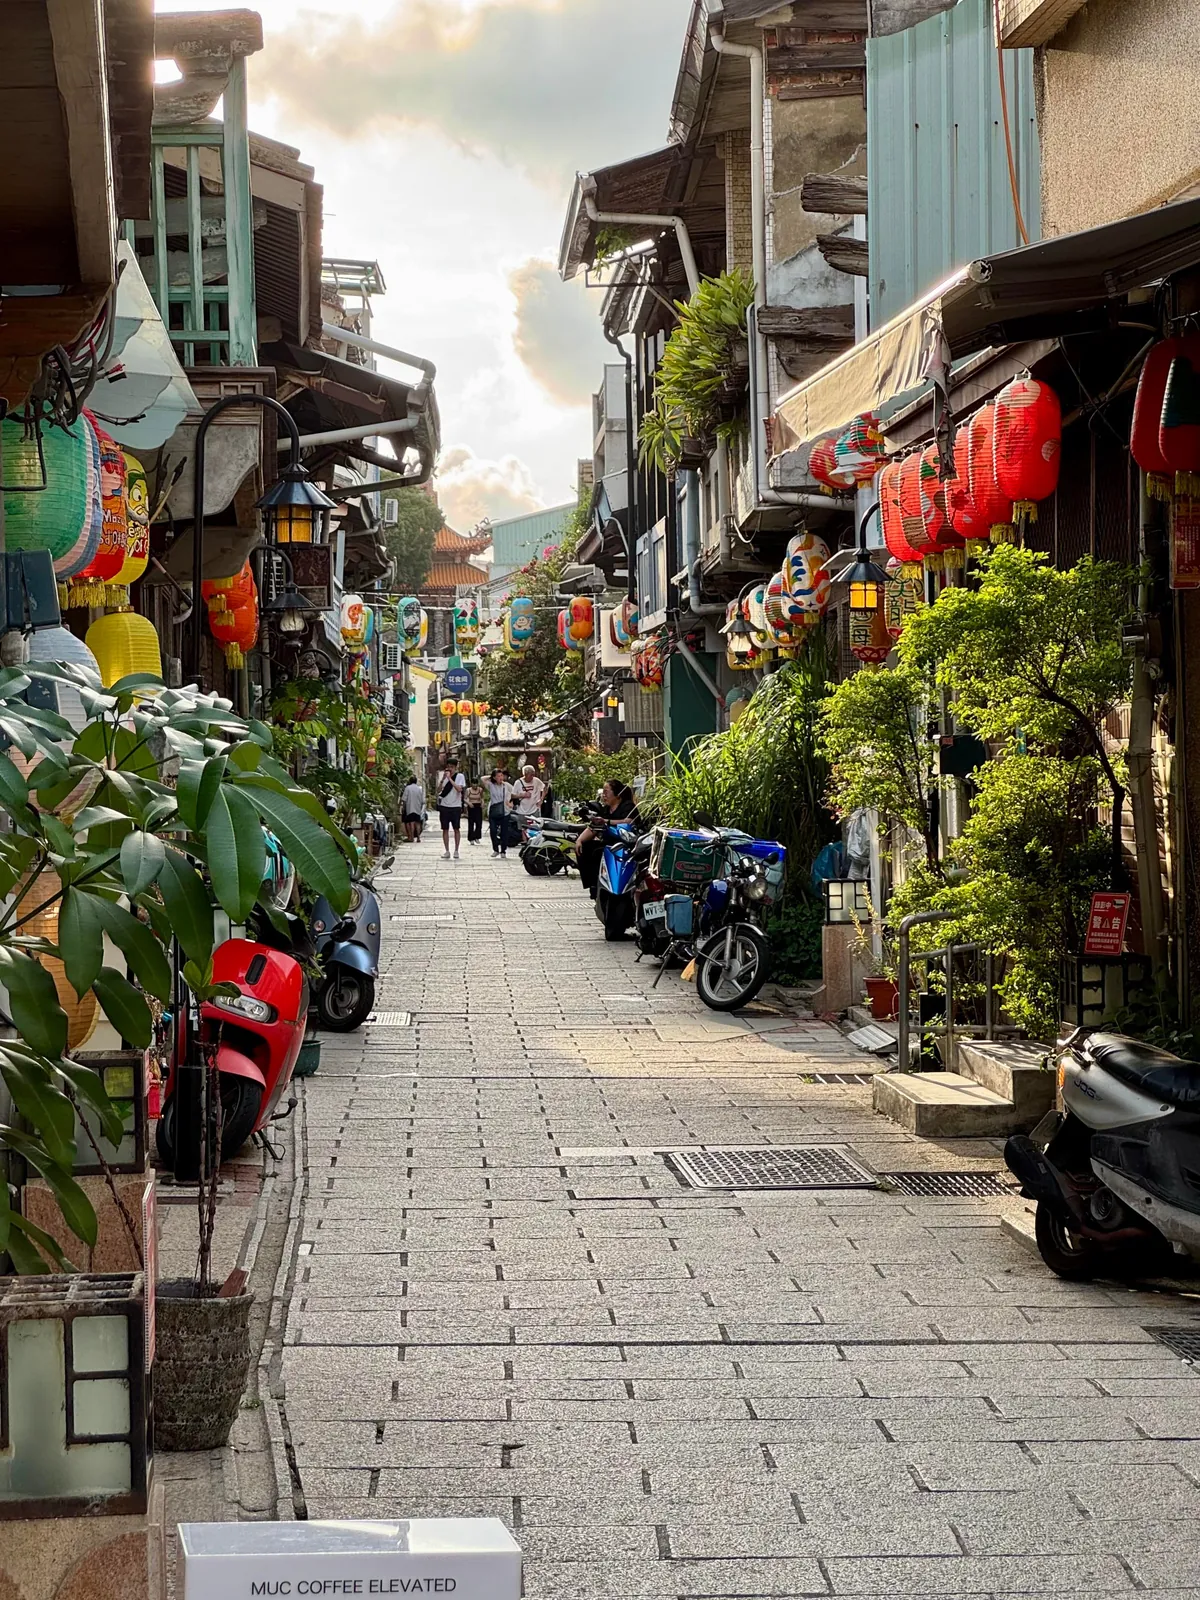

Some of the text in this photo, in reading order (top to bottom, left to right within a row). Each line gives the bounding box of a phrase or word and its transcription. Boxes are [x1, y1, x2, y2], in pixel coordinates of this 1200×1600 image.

[1111, 916, 1121, 930] 告
[251, 1578, 457, 1595] MUC COFFEE ELEVATED
